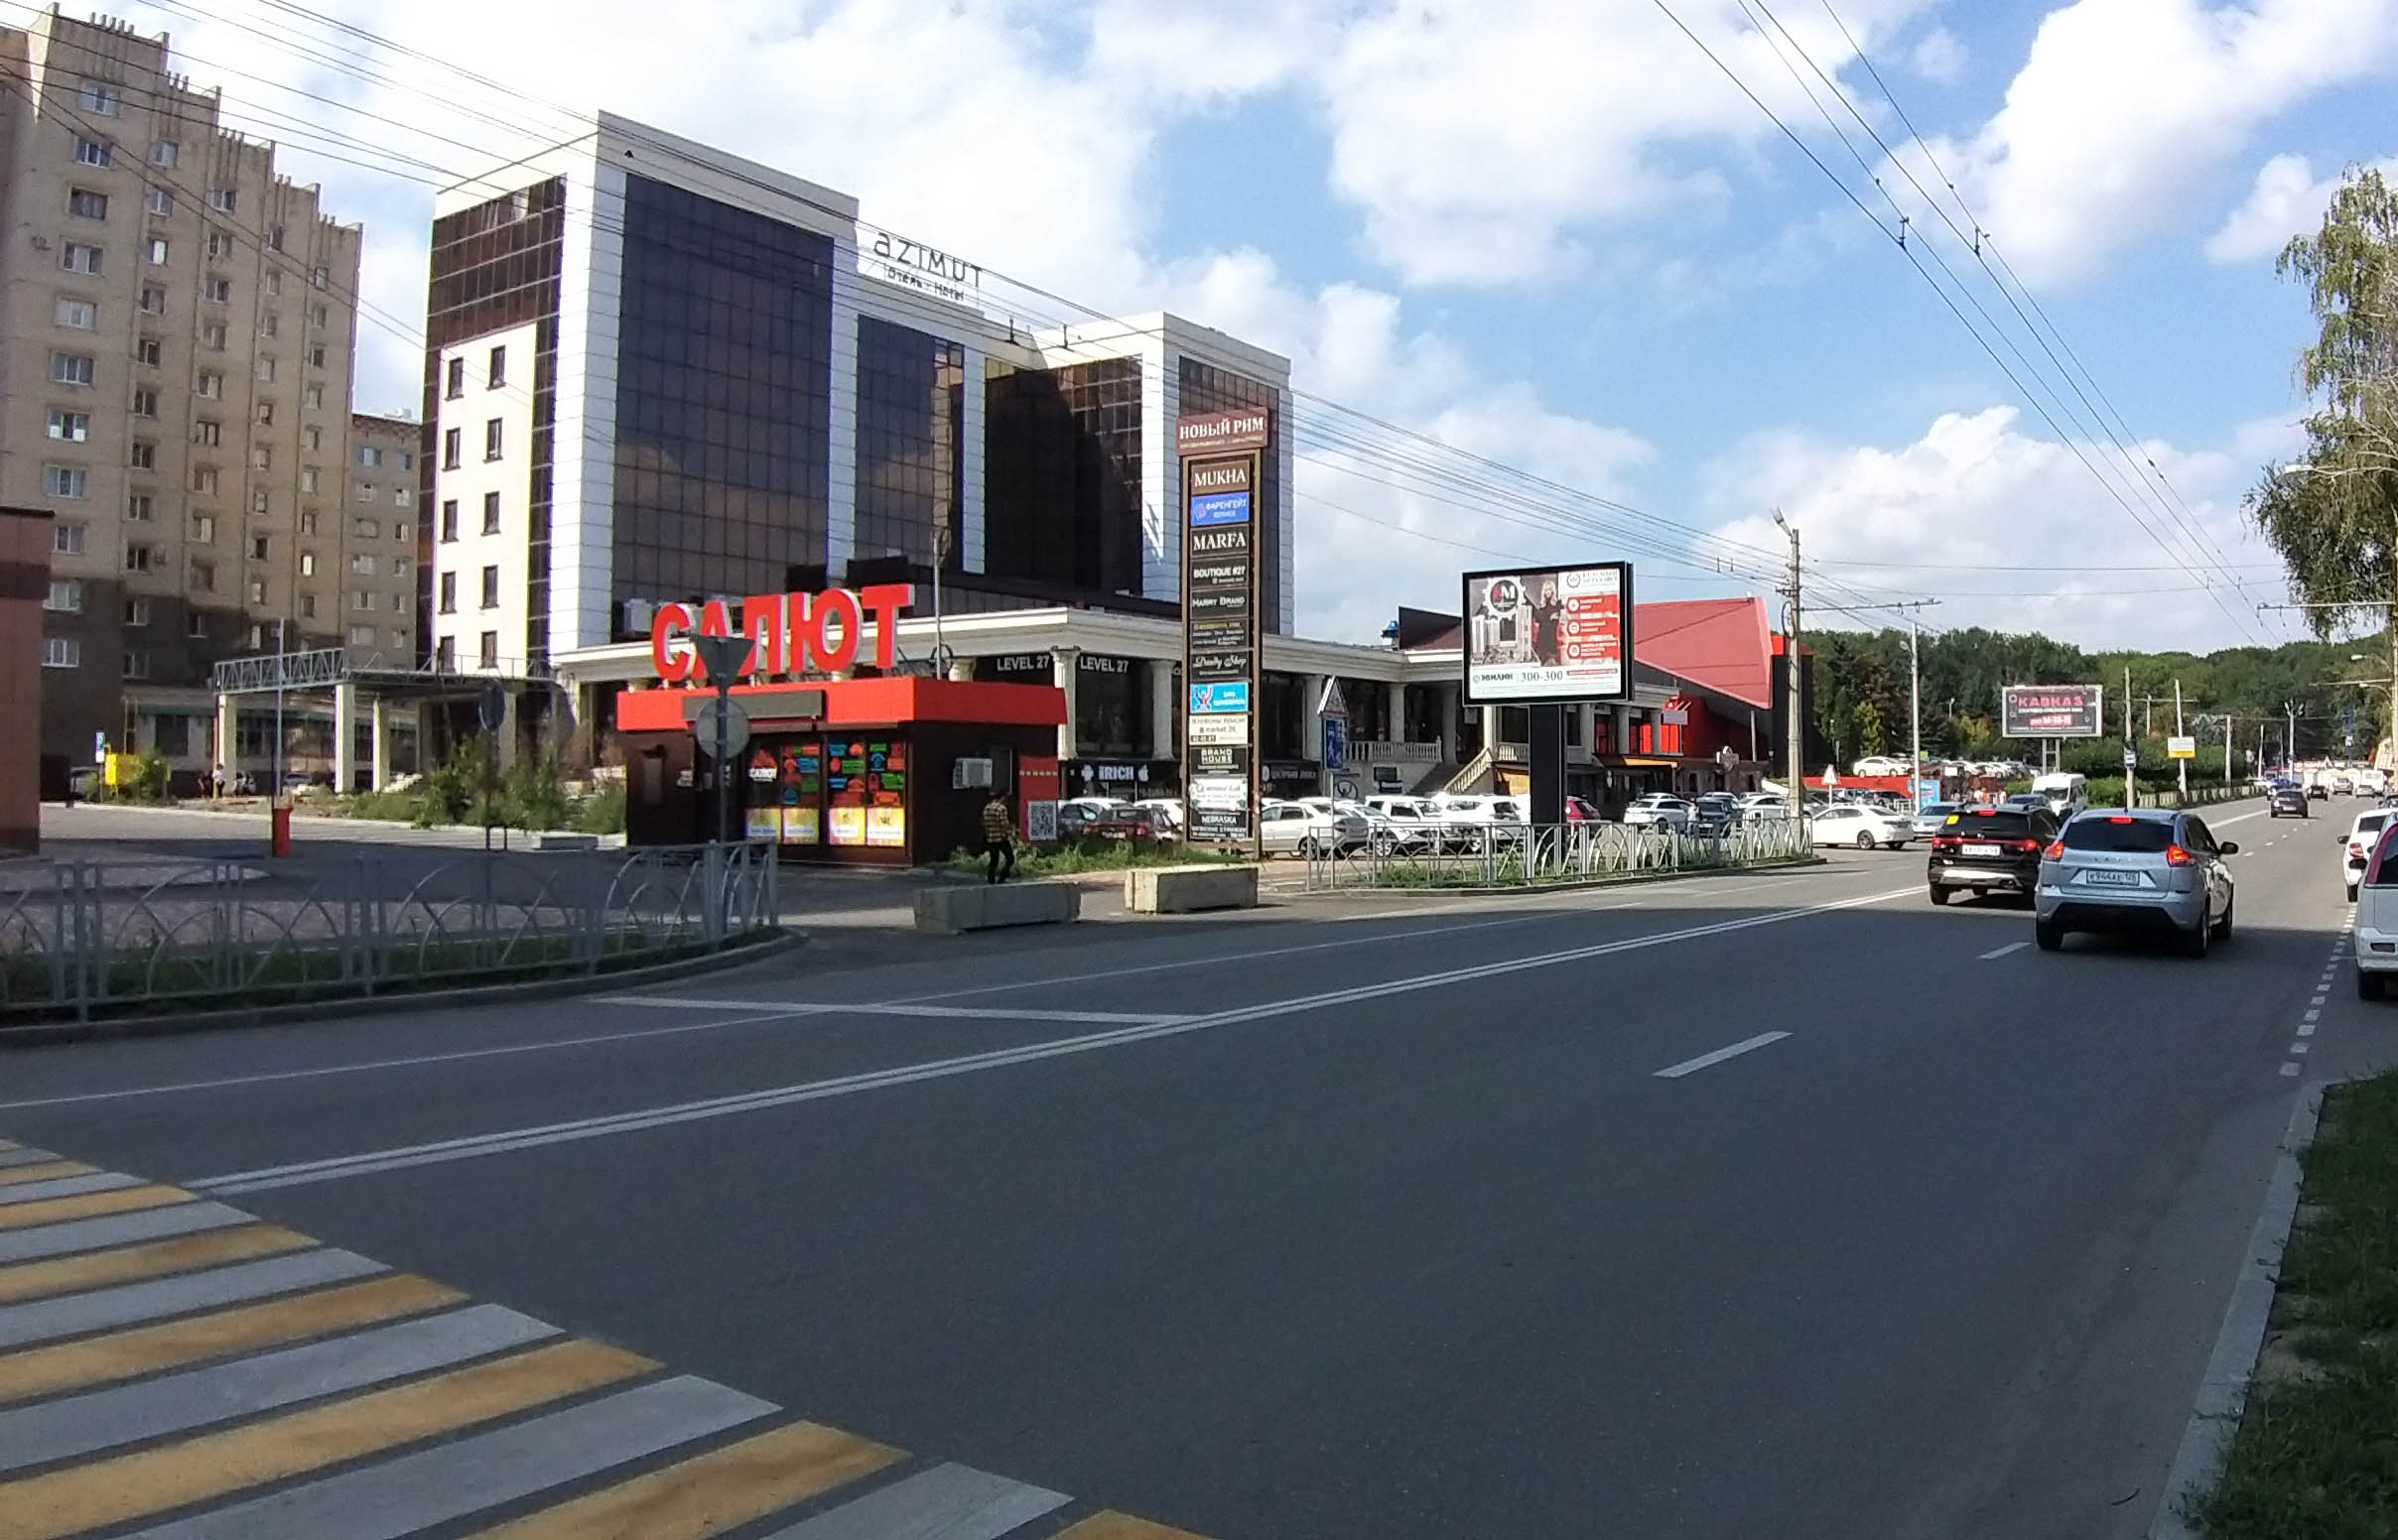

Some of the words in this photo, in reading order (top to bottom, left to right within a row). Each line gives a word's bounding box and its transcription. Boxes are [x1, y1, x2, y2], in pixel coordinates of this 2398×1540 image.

[1179, 417, 1231, 440] НОВЫЙ
[1233, 416, 1265, 434] РИМ
[1194, 467, 1247, 487] MUKHA
[1193, 532, 1247, 551] MARFA
[1193, 567, 1232, 578] BOUTIQUE
[652, 583, 914, 682] САЛЮТ
[997, 657, 1034, 672] LEVEL
[1036, 655, 1050, 669] 27
[1080, 657, 1116, 673] LEVEL
[1117, 660, 1130, 674] 27
[1521, 671, 1563, 683] 300-300
[2018, 696, 2084, 707] КАВКАЗ
[1098, 765, 1134, 780] iRICH
[1201, 816, 1237, 825] NEBRASKA
